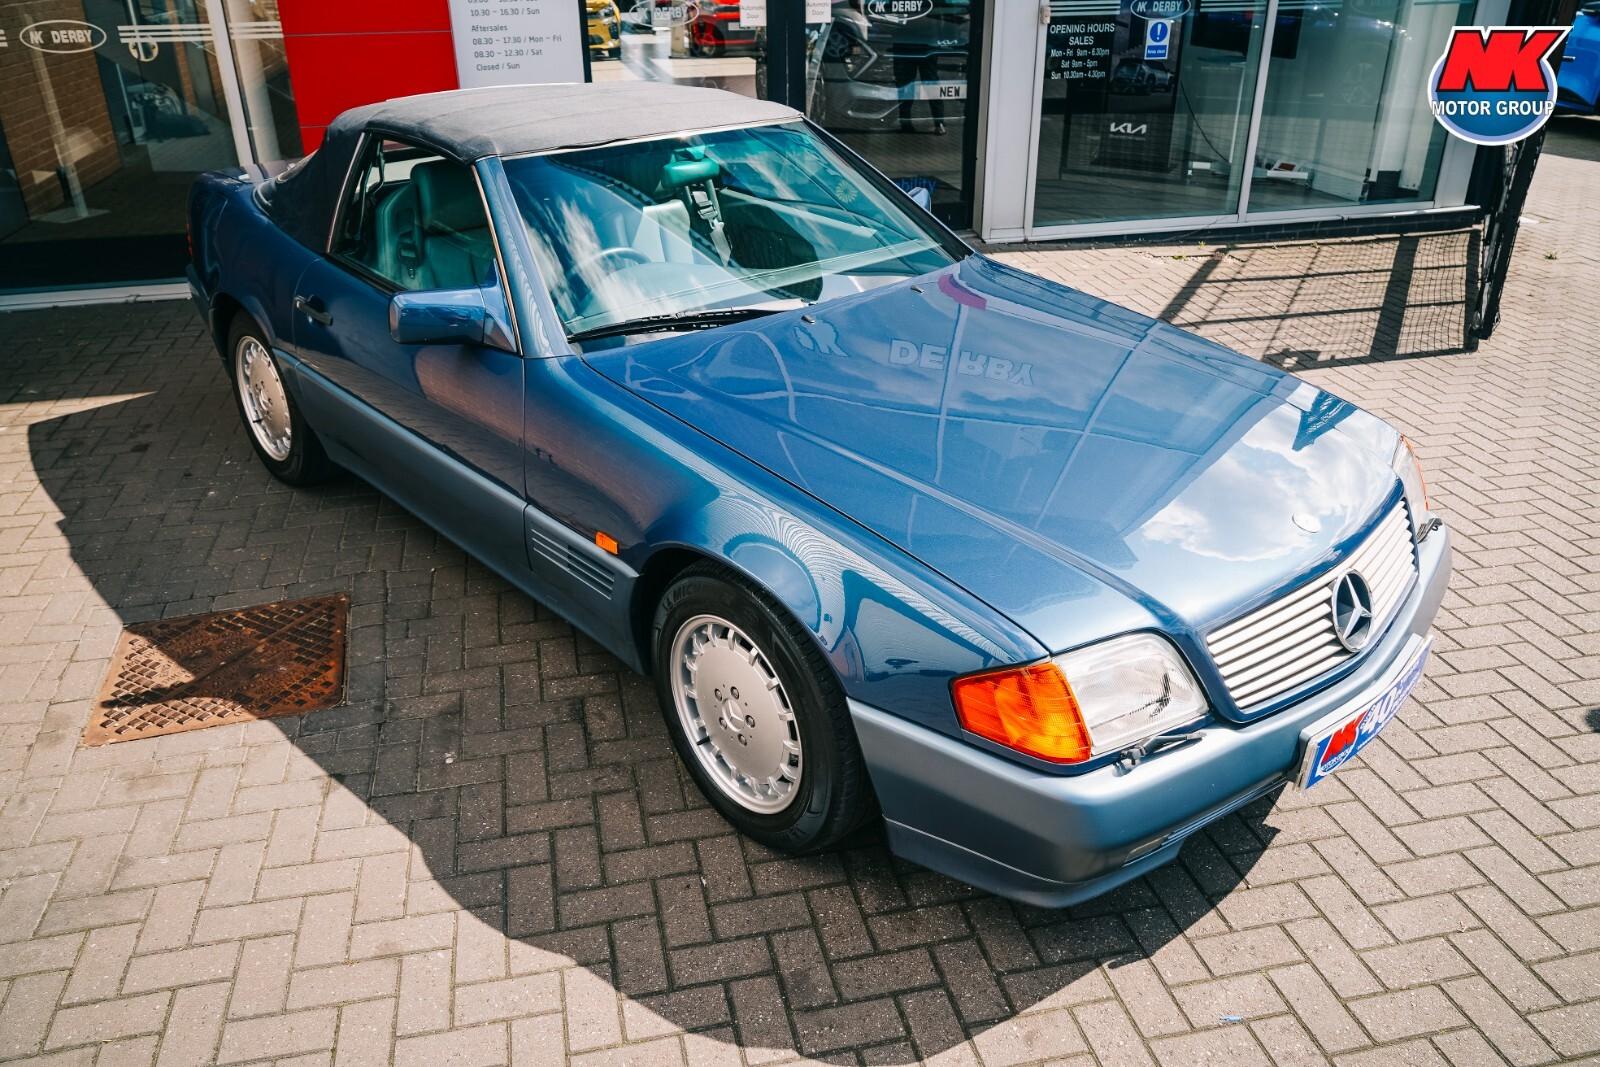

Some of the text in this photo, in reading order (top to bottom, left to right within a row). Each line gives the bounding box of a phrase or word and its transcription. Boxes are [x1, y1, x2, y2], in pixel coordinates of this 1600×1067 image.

[892, 1, 923, 12] DERBY
[1152, 1, 1182, 12] DERBY
[471, 24, 508, 32] Aftersales
[1050, 23, 1116, 34] OPENING HOURS
[50, 29, 92, 44] DERBY
[529, 35, 544, 43] Mon
[552, 34, 562, 42] Fri
[1068, 36, 1094, 46] SALES
[531, 48, 543, 56] Sat
[1050, 49, 1063, 58] Mon
[1066, 48, 1074, 57] Fri
[1076, 48, 1088, 57] 9am
[476, 62, 500, 71] Closed
[1061, 60, 1071, 69] Sat
[1071, 59, 1083, 68] 9am
[1086, 58, 1098, 69] 5pm
[1051, 71, 1062, 80] Sun
[940, 86, 961, 98] NEW
